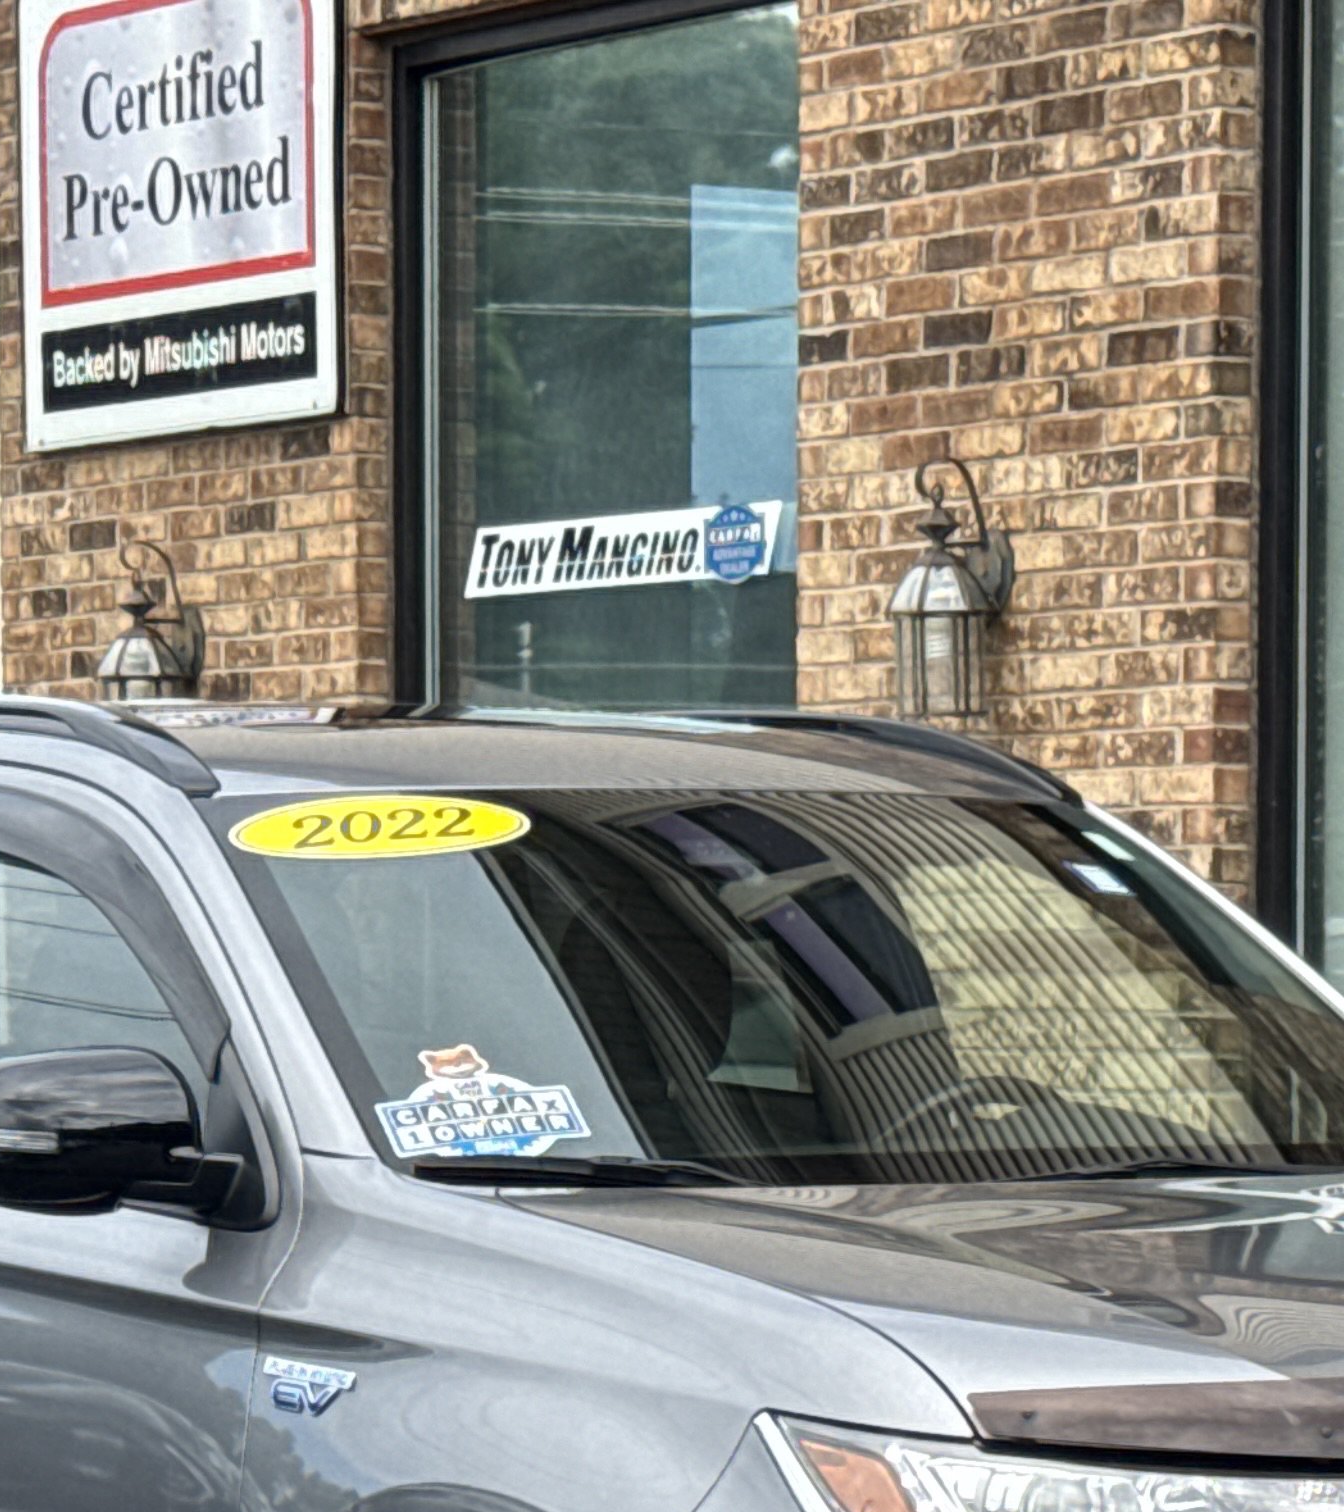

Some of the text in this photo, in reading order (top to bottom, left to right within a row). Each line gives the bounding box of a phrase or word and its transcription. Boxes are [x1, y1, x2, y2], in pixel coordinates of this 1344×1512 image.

[82, 40, 264, 141] Certified
[62, 135, 292, 241] Pre-Owned
[52, 321, 305, 389] Backed by Mitsubishi Motors
[477, 533, 555, 588] TONY
[292, 806, 476, 849] 2022
[393, 1096, 562, 1126] CARFAX
